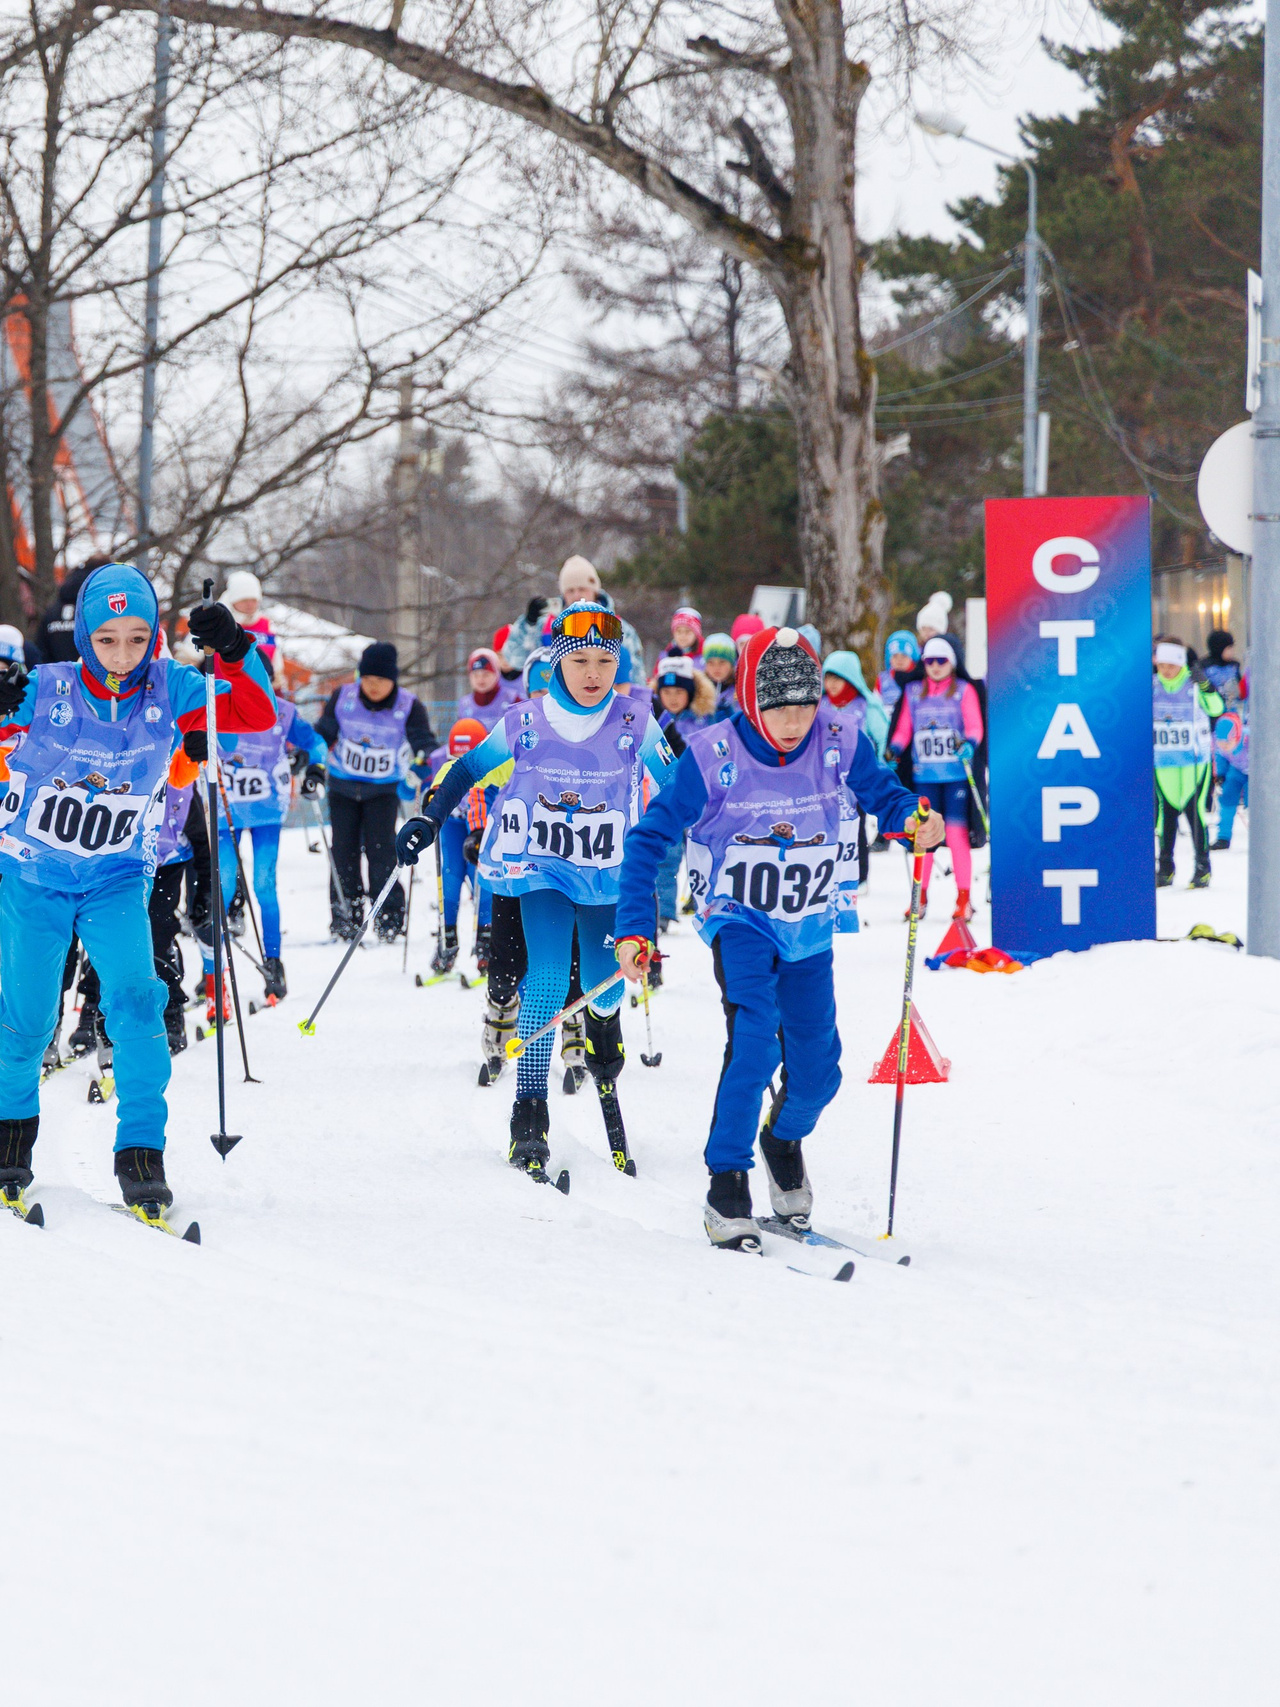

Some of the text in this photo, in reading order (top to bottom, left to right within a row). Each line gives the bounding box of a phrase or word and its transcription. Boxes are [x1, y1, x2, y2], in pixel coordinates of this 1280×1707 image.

[1031, 535, 1102, 925] СТАРТ
[345, 750, 390, 773] 1005
[532, 819, 616, 861] 1014
[724, 858, 835, 914] 1032
